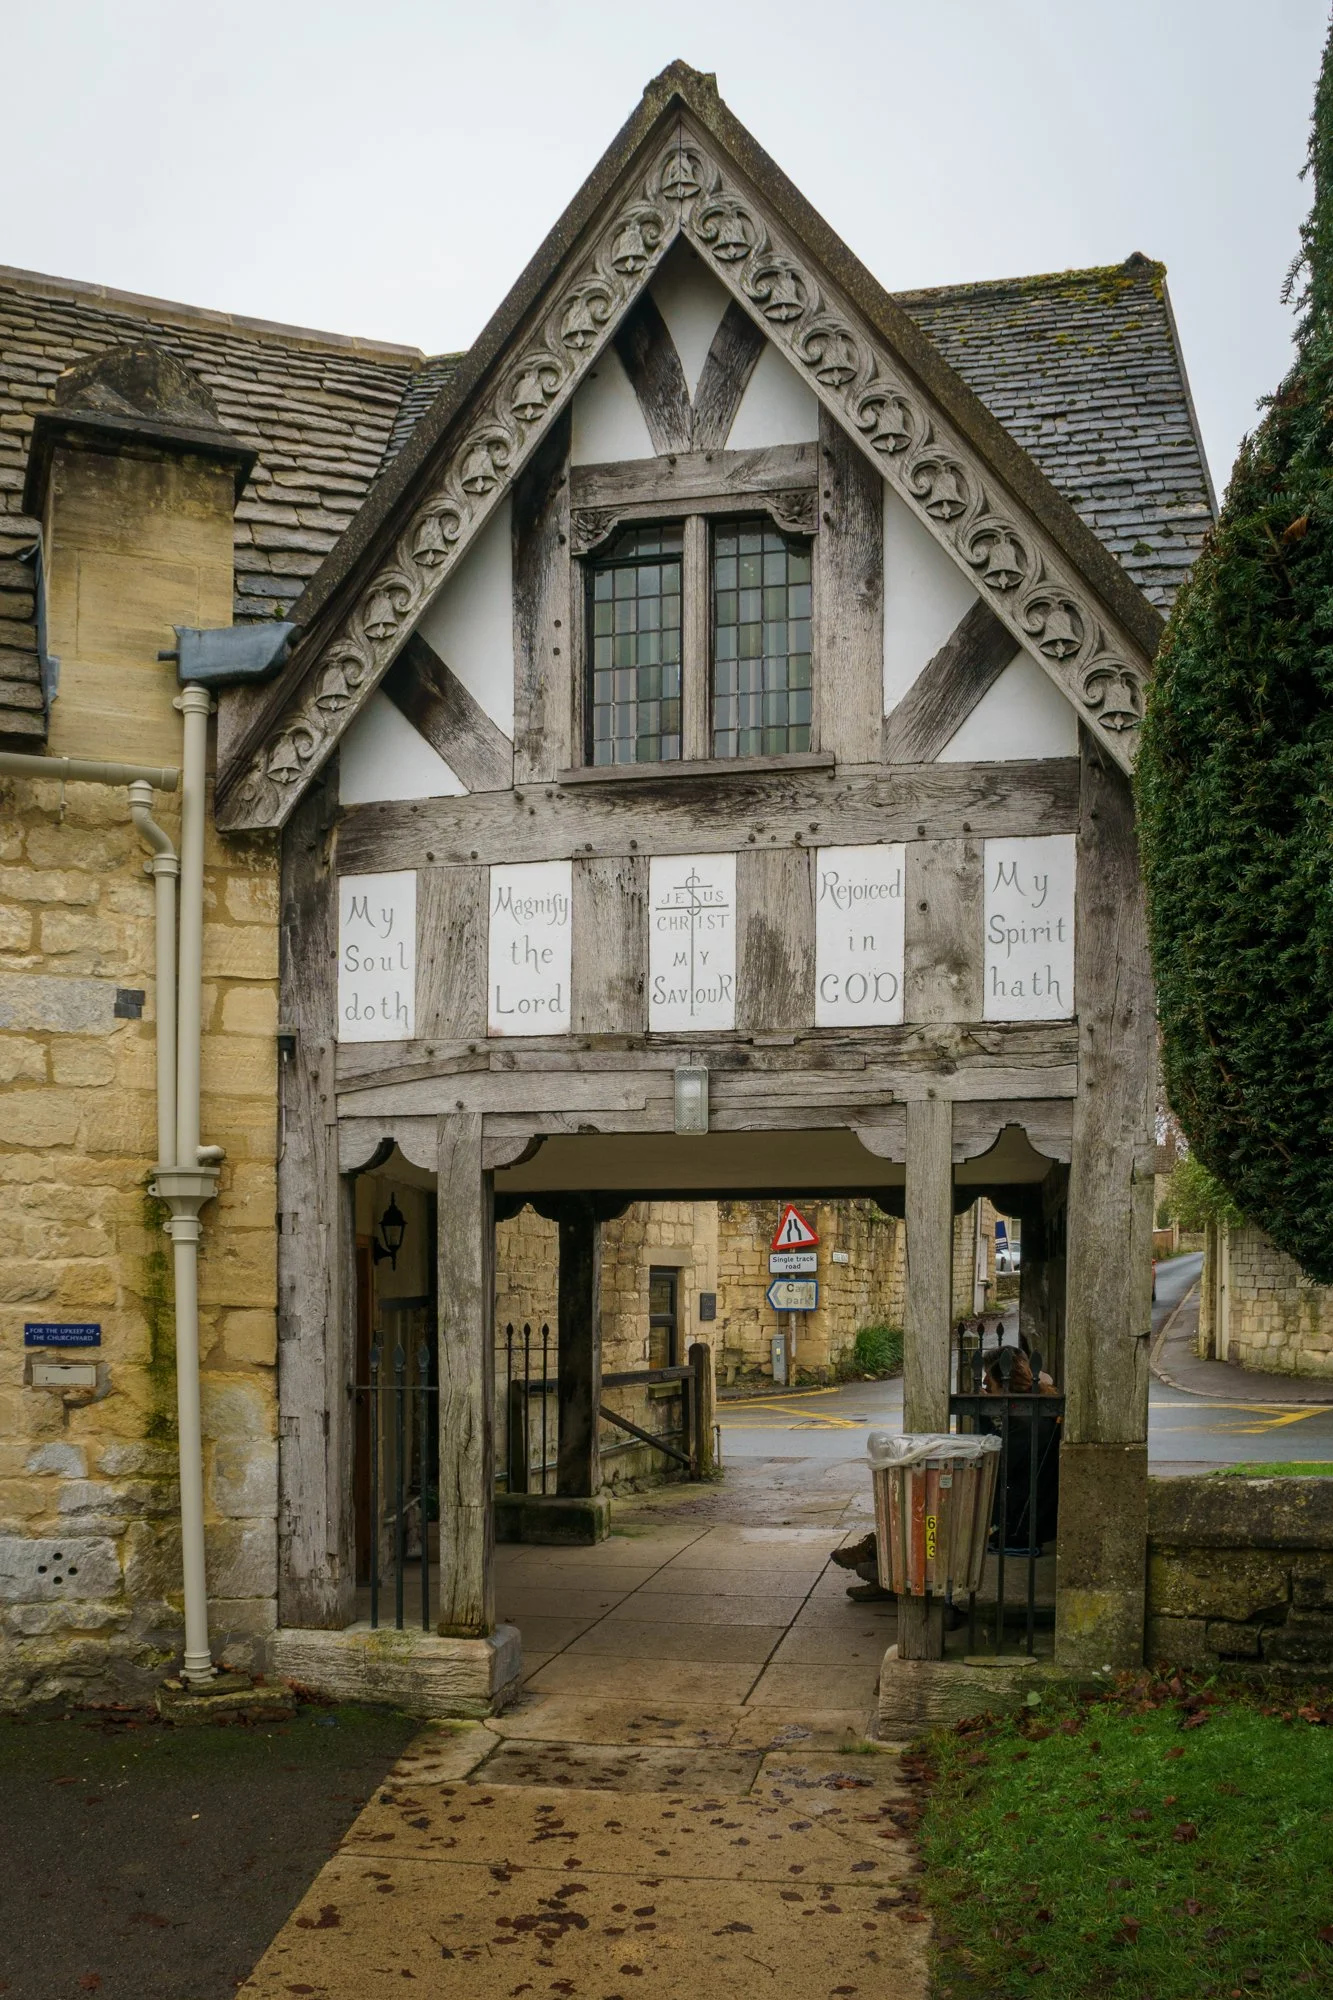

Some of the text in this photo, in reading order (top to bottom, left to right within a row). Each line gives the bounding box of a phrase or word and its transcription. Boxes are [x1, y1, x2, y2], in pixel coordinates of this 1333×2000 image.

[661, 875, 724, 916] JESUS
[819, 868, 900, 910] Rejoiced
[991, 861, 1049, 908] My
[346, 895, 395, 939] My
[493, 886, 570, 926] Magnify
[656, 914, 730, 931] CHRIST
[509, 934, 554, 974] the
[848, 929, 877, 951] in
[988, 914, 1067, 958] Spirit
[344, 942, 409, 973] Soul
[672, 951, 710, 967] MY
[495, 983, 565, 1015] Lord
[990, 964, 1064, 1008] hath
[345, 991, 409, 1029] doth
[772, 1256, 794, 1264] Single
